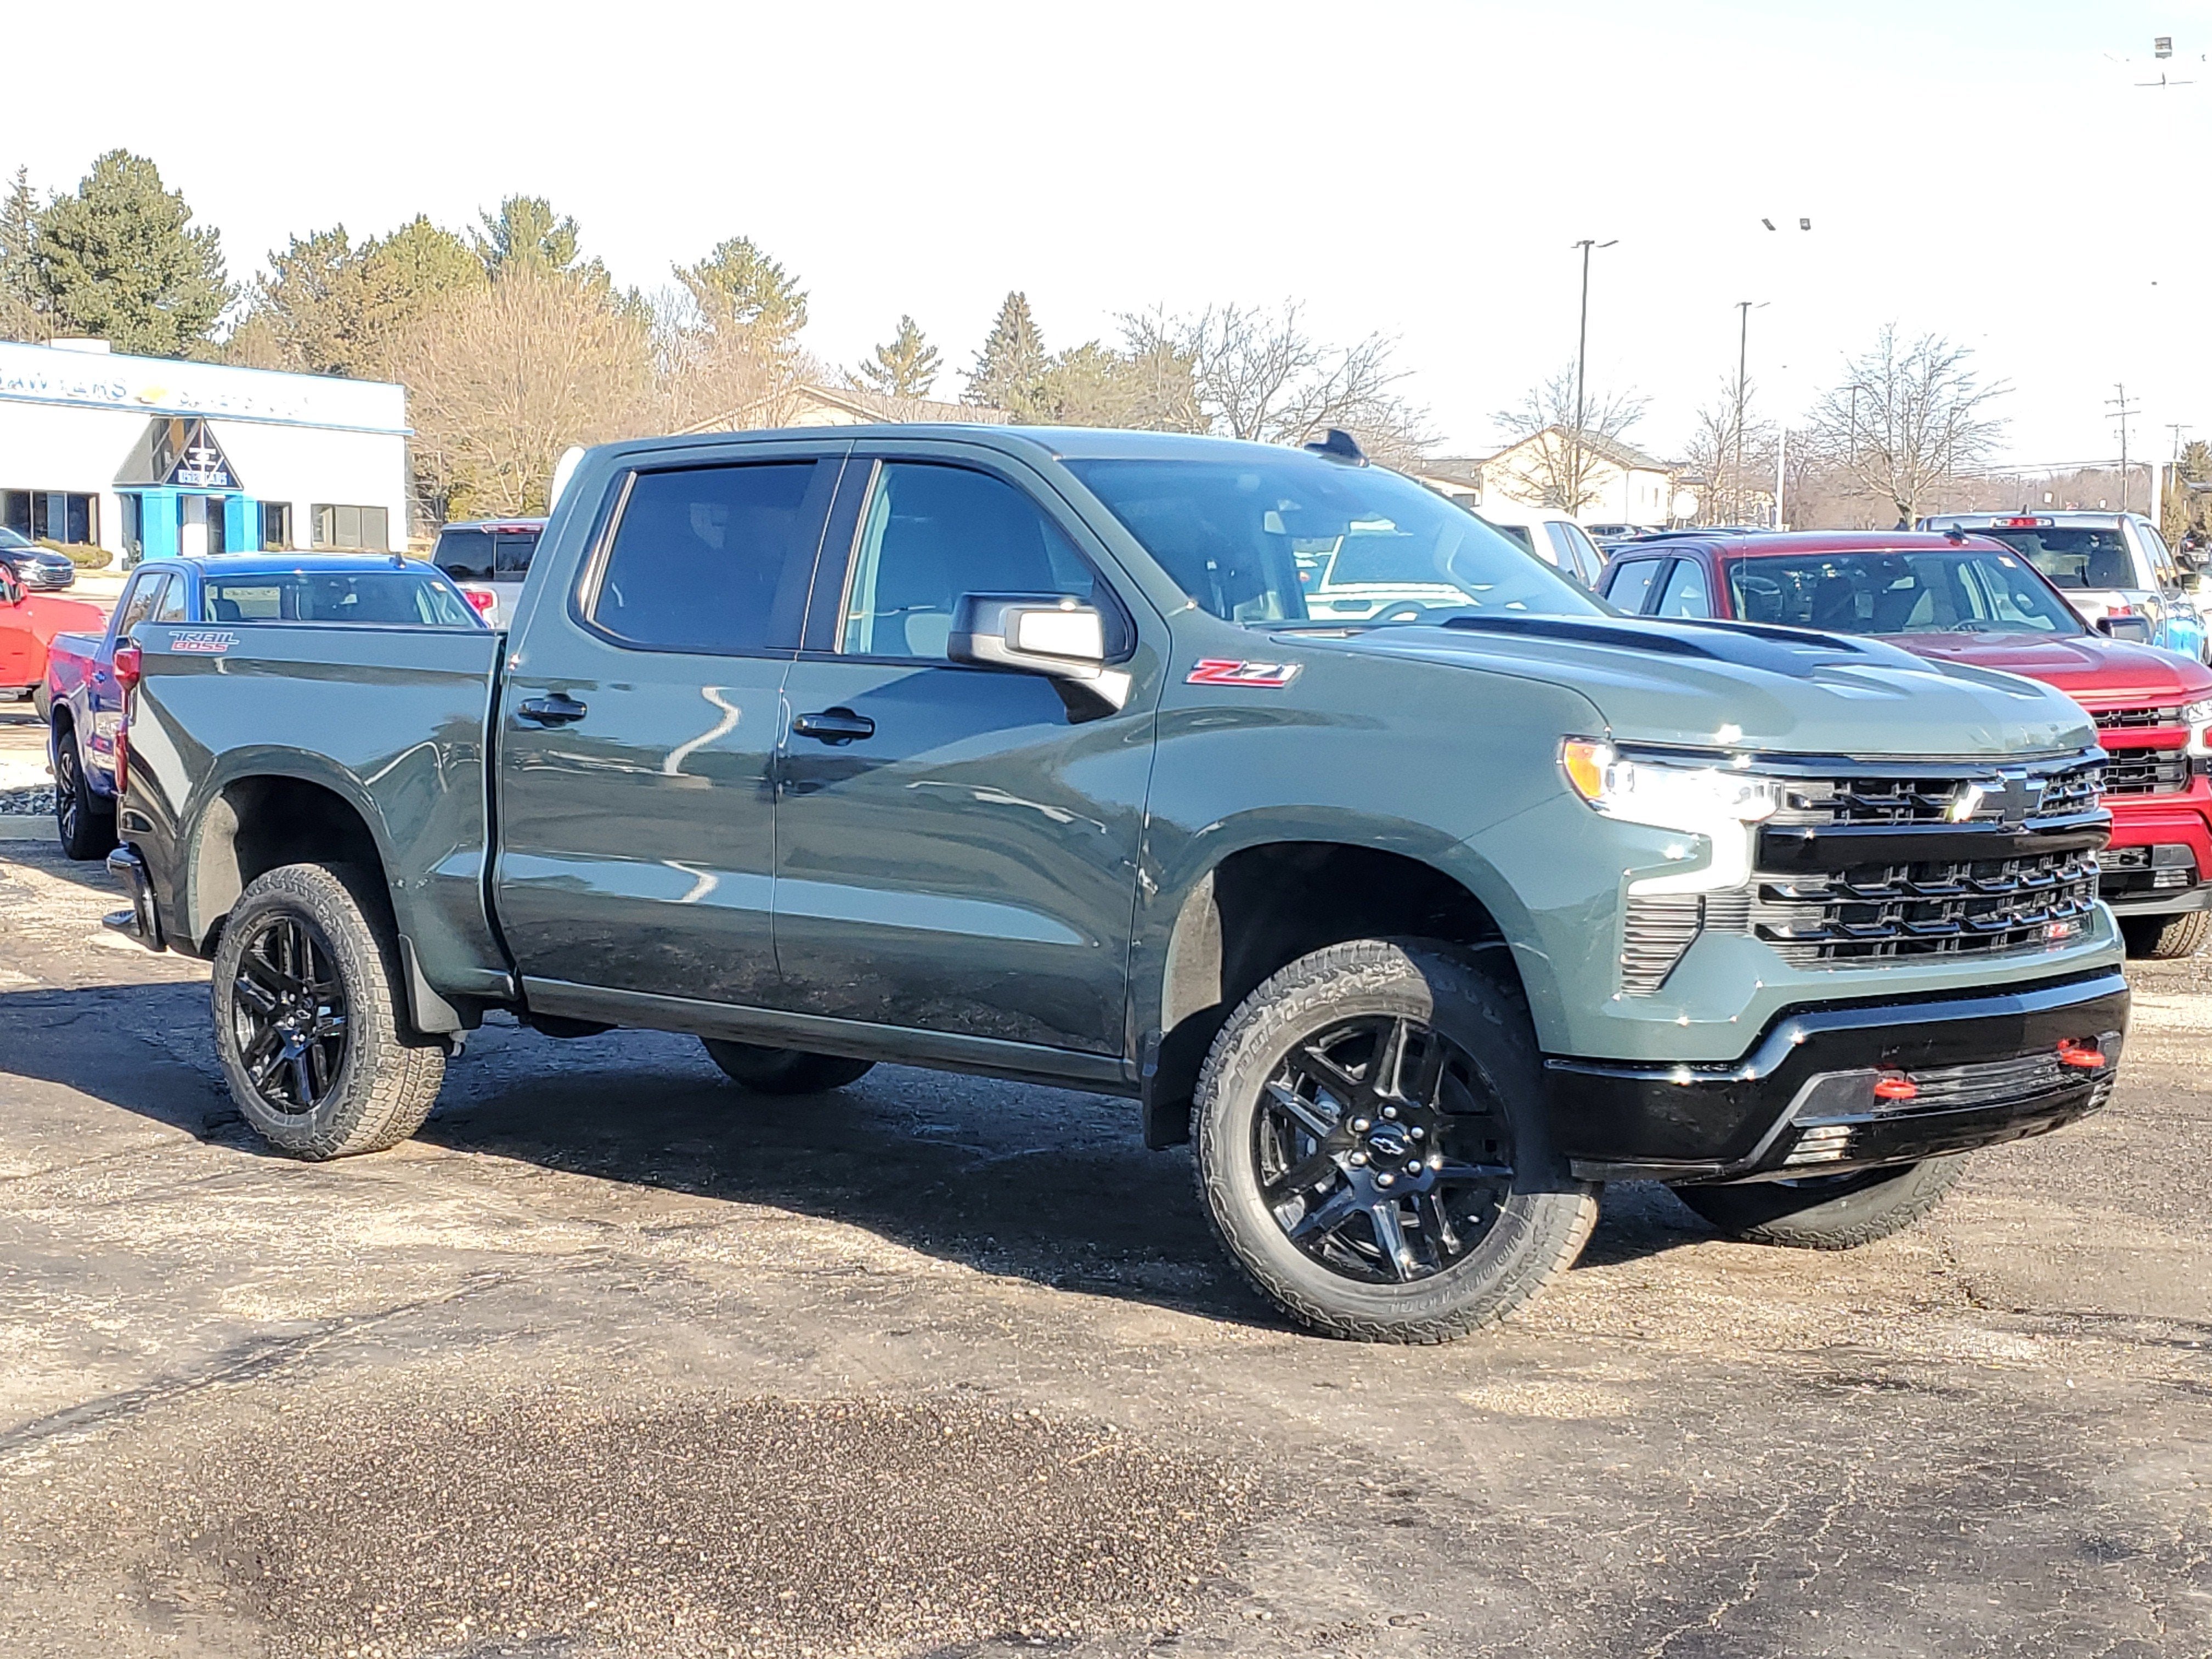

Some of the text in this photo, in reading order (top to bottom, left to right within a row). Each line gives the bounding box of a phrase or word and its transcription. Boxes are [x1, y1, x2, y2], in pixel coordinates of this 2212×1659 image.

[168, 631, 240, 645] TRAIL
[171, 641, 229, 652] BOSS
[1186, 659, 1304, 689] Z71
